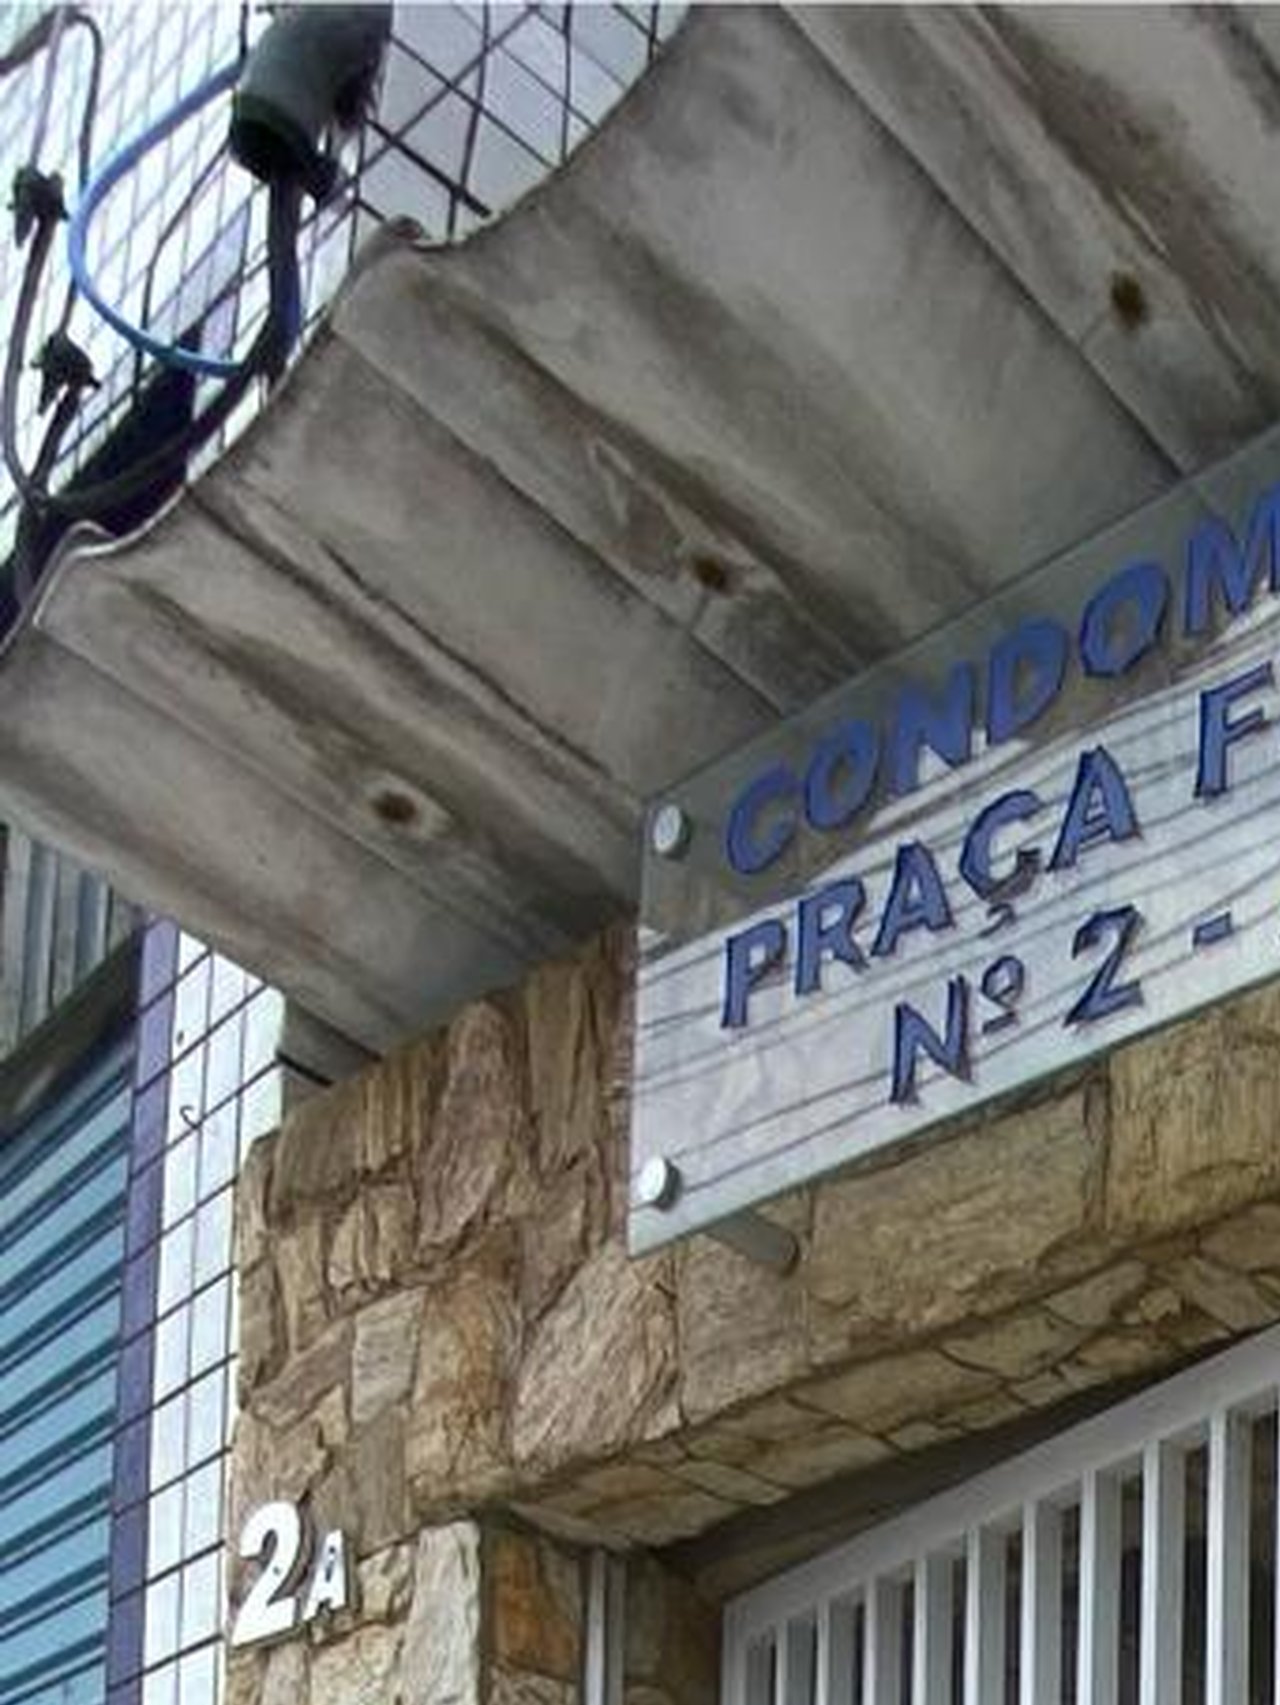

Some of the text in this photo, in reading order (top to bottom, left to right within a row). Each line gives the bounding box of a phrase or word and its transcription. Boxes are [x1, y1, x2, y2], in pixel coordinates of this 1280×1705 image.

[721, 745, 1142, 1029] PRAÇA
[1064, 905, 1144, 1029] 2
[1193, 911, 1234, 943] -
